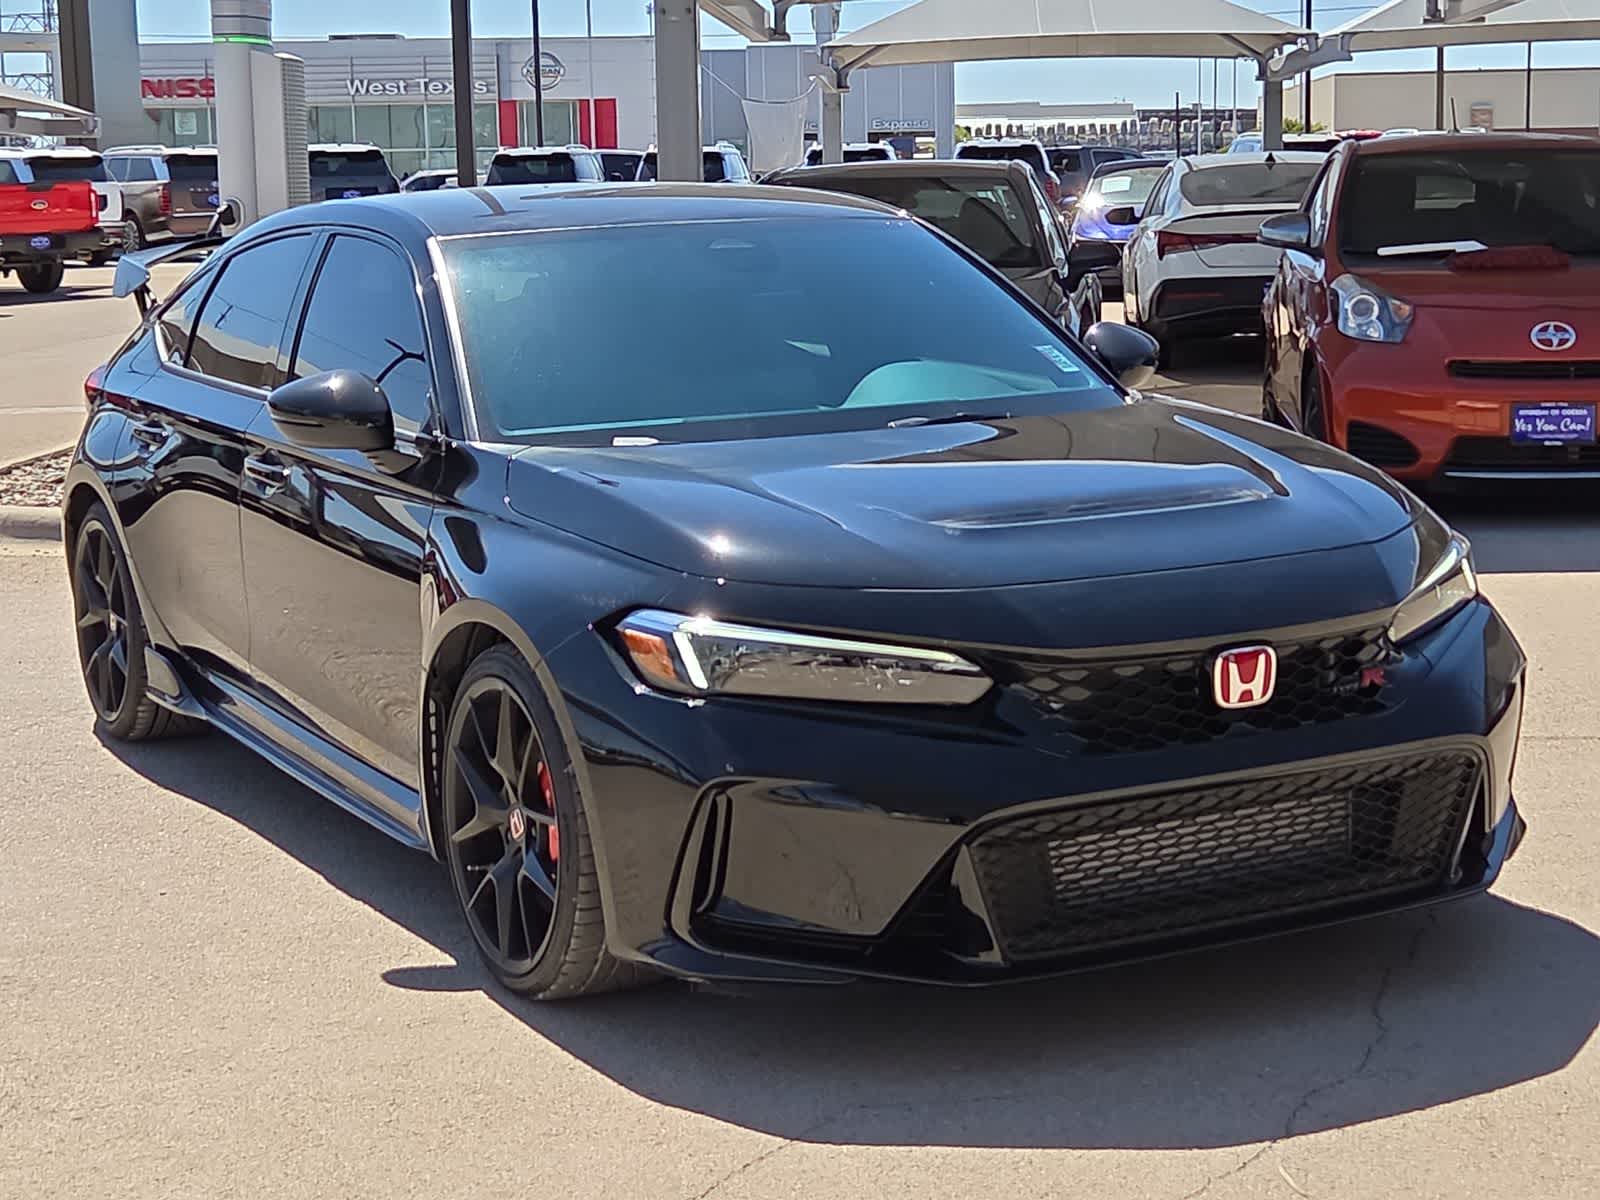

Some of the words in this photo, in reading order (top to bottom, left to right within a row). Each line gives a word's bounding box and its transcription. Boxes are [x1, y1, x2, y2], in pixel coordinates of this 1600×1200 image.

[346, 79, 407, 96] West
[415, 78, 488, 95] Texs
[871, 119, 929, 130] Express
[1535, 418, 1558, 432] You
[1560, 417, 1592, 432] Can!
